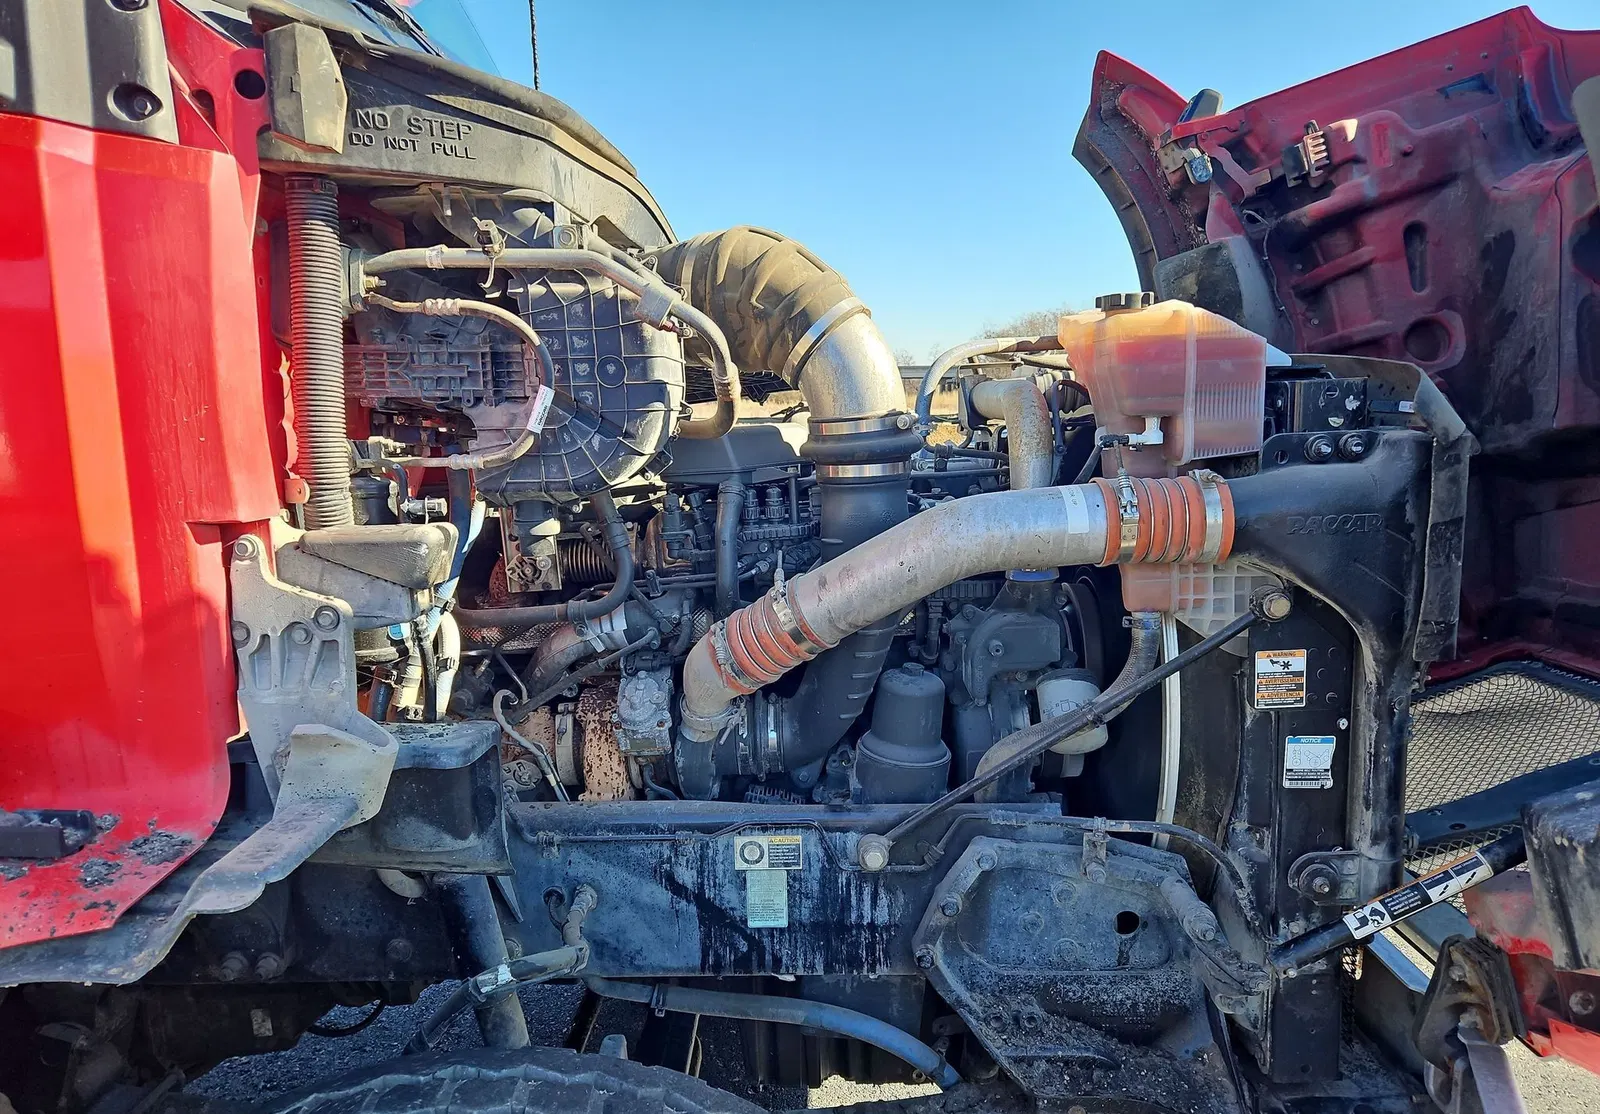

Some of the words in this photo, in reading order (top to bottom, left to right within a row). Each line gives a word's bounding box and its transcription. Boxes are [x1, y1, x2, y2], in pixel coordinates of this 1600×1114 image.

[355, 108, 390, 131] NO
[407, 116, 472, 140] STEP
[349, 132, 375, 147] DO
[384, 135, 419, 152] NOT
[431, 141, 477, 160] PULL
